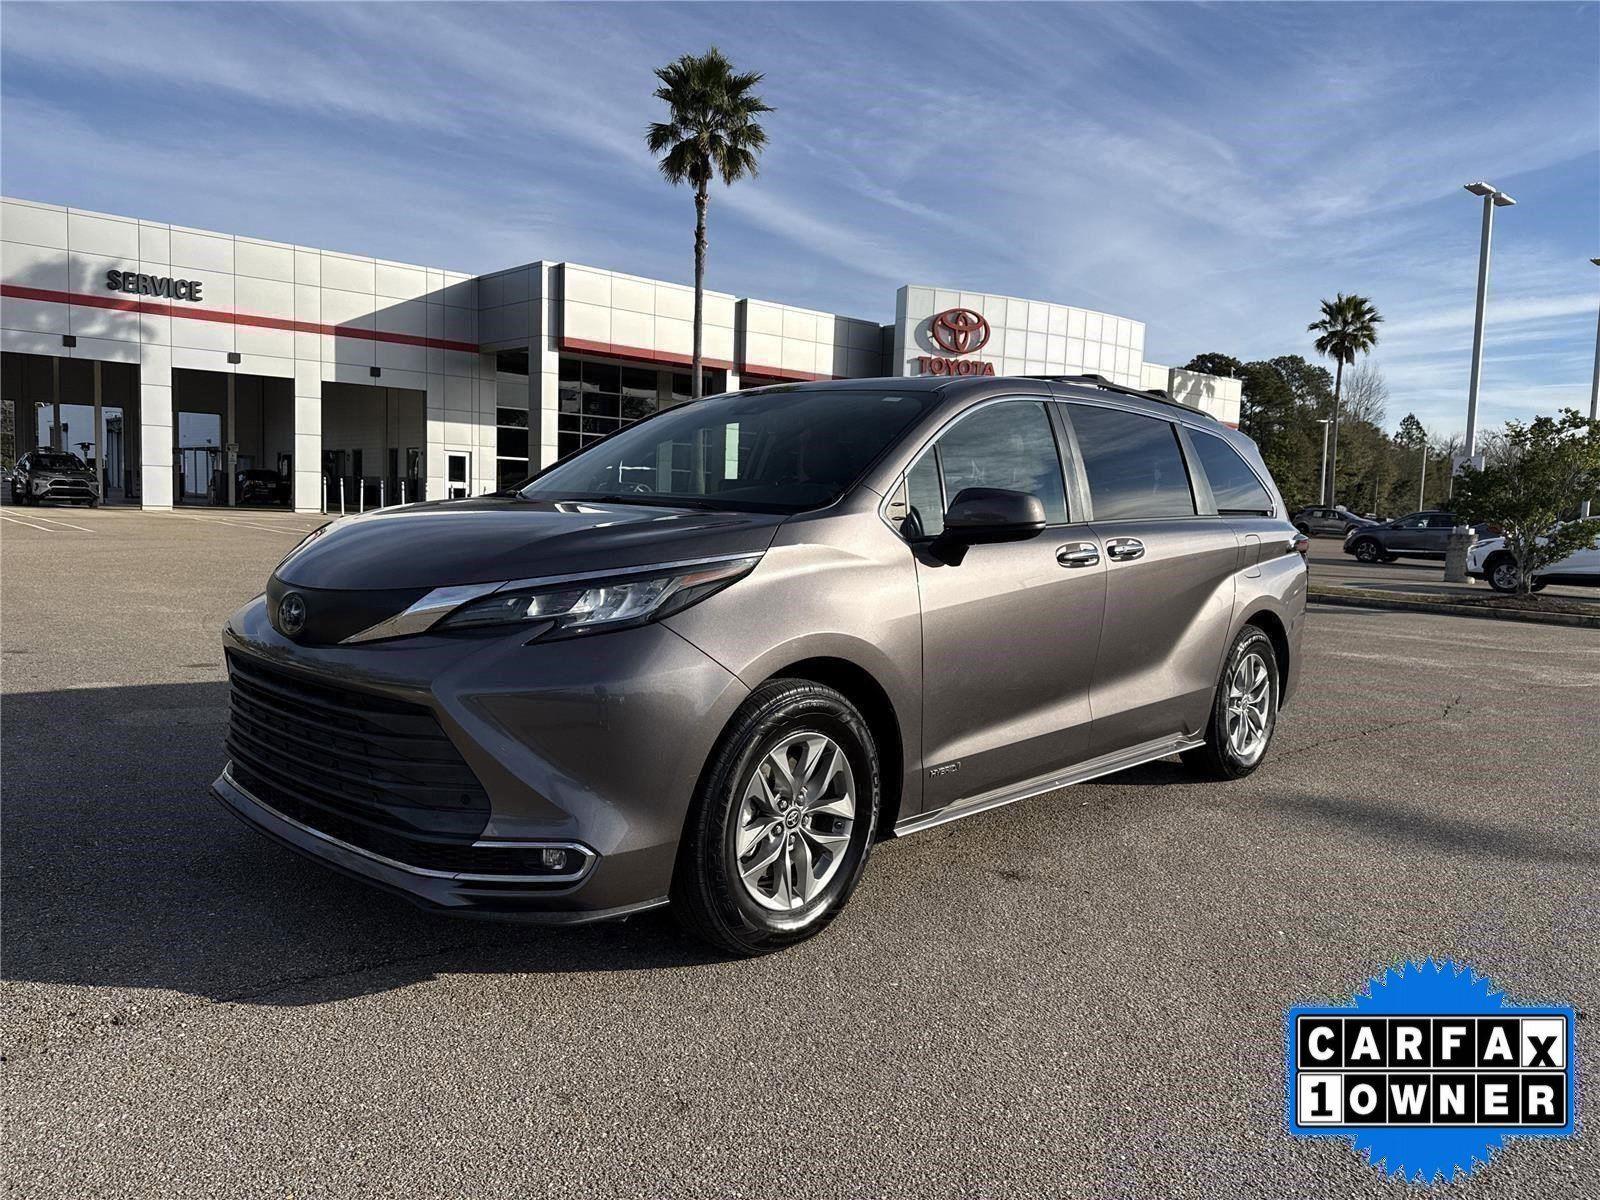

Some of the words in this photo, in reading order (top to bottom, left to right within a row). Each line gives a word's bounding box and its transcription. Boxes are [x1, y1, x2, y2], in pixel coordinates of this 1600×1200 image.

[106, 269, 203, 302] SERVICE
[918, 356, 996, 377] TOYOTA
[929, 763, 957, 779] HYBRID
